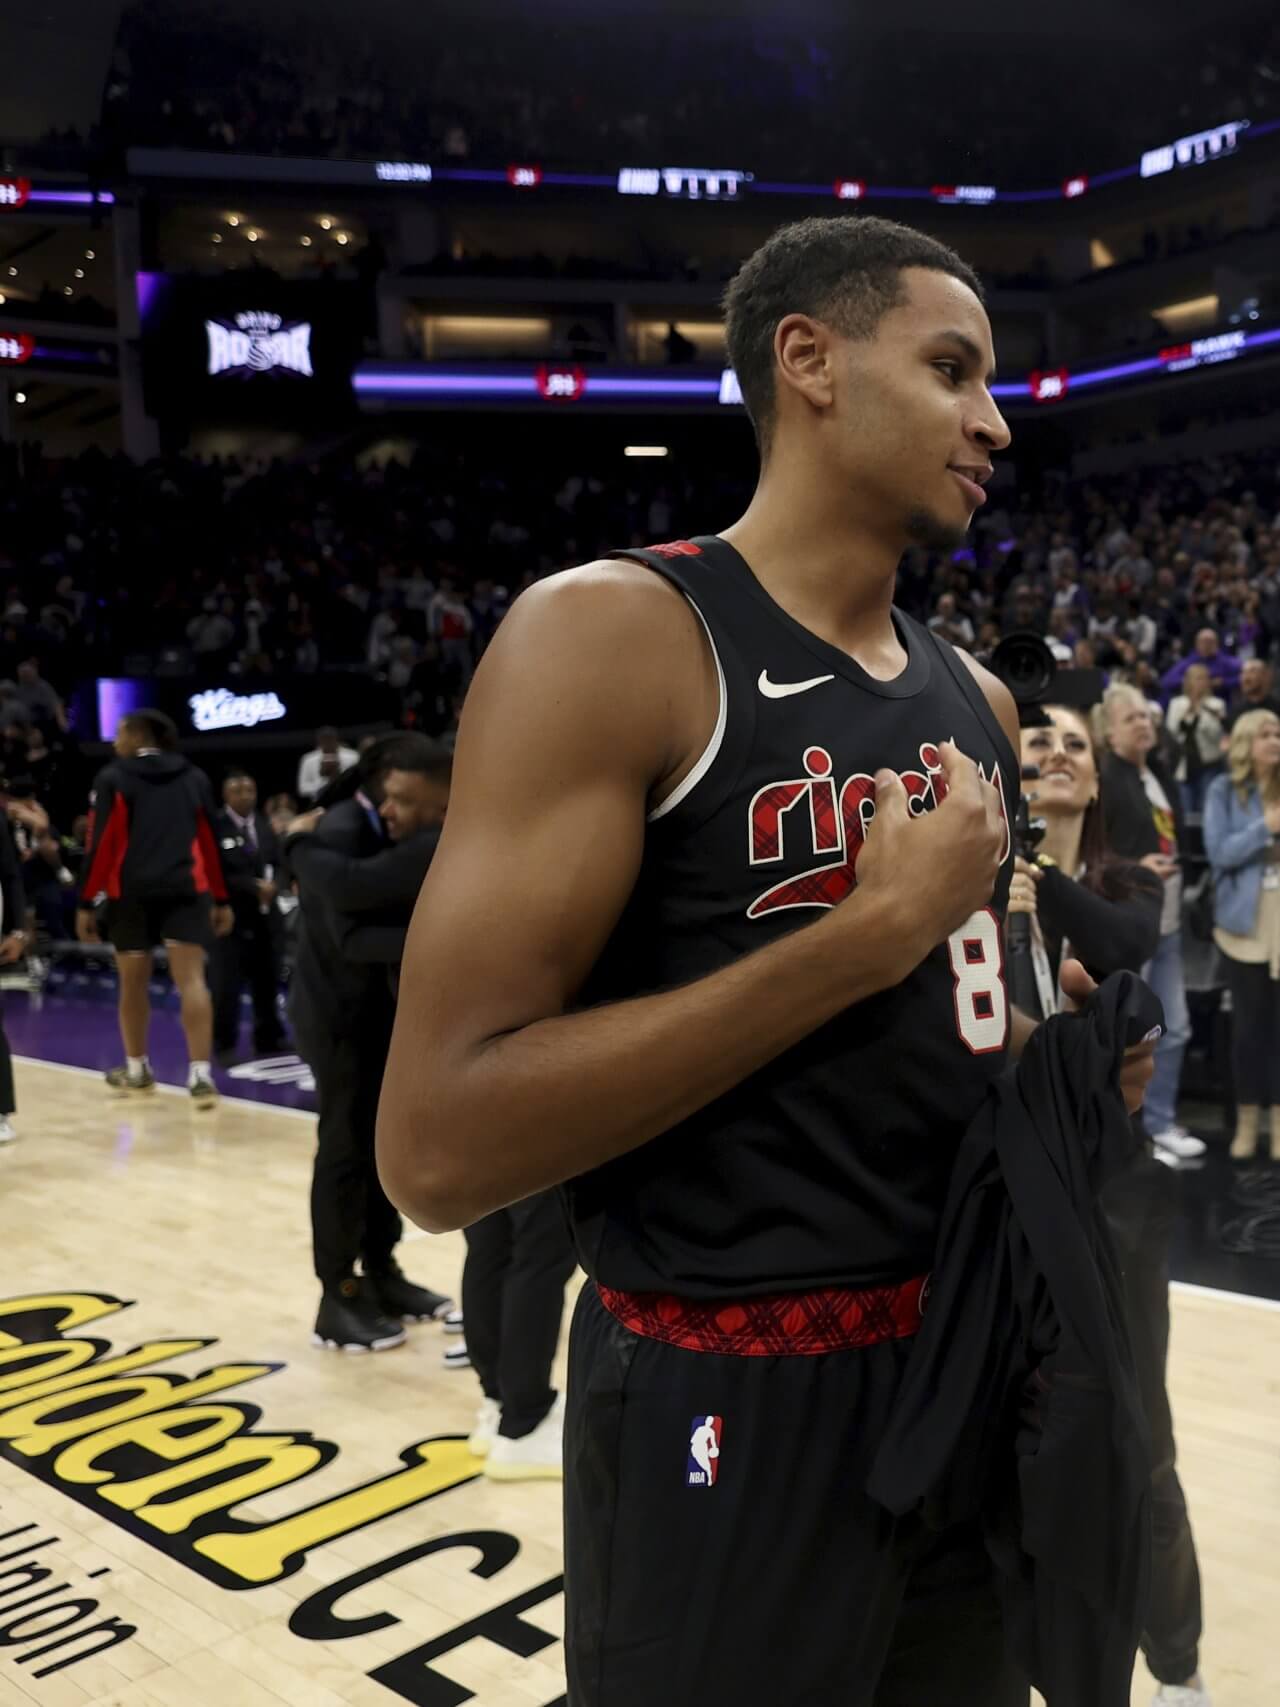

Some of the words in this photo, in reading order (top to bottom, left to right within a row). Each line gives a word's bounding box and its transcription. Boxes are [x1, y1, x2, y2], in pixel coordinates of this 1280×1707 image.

[188, 687, 287, 731] Kings
[947, 905, 1012, 1055] 8
[689, 1471, 705, 1484] NBA
